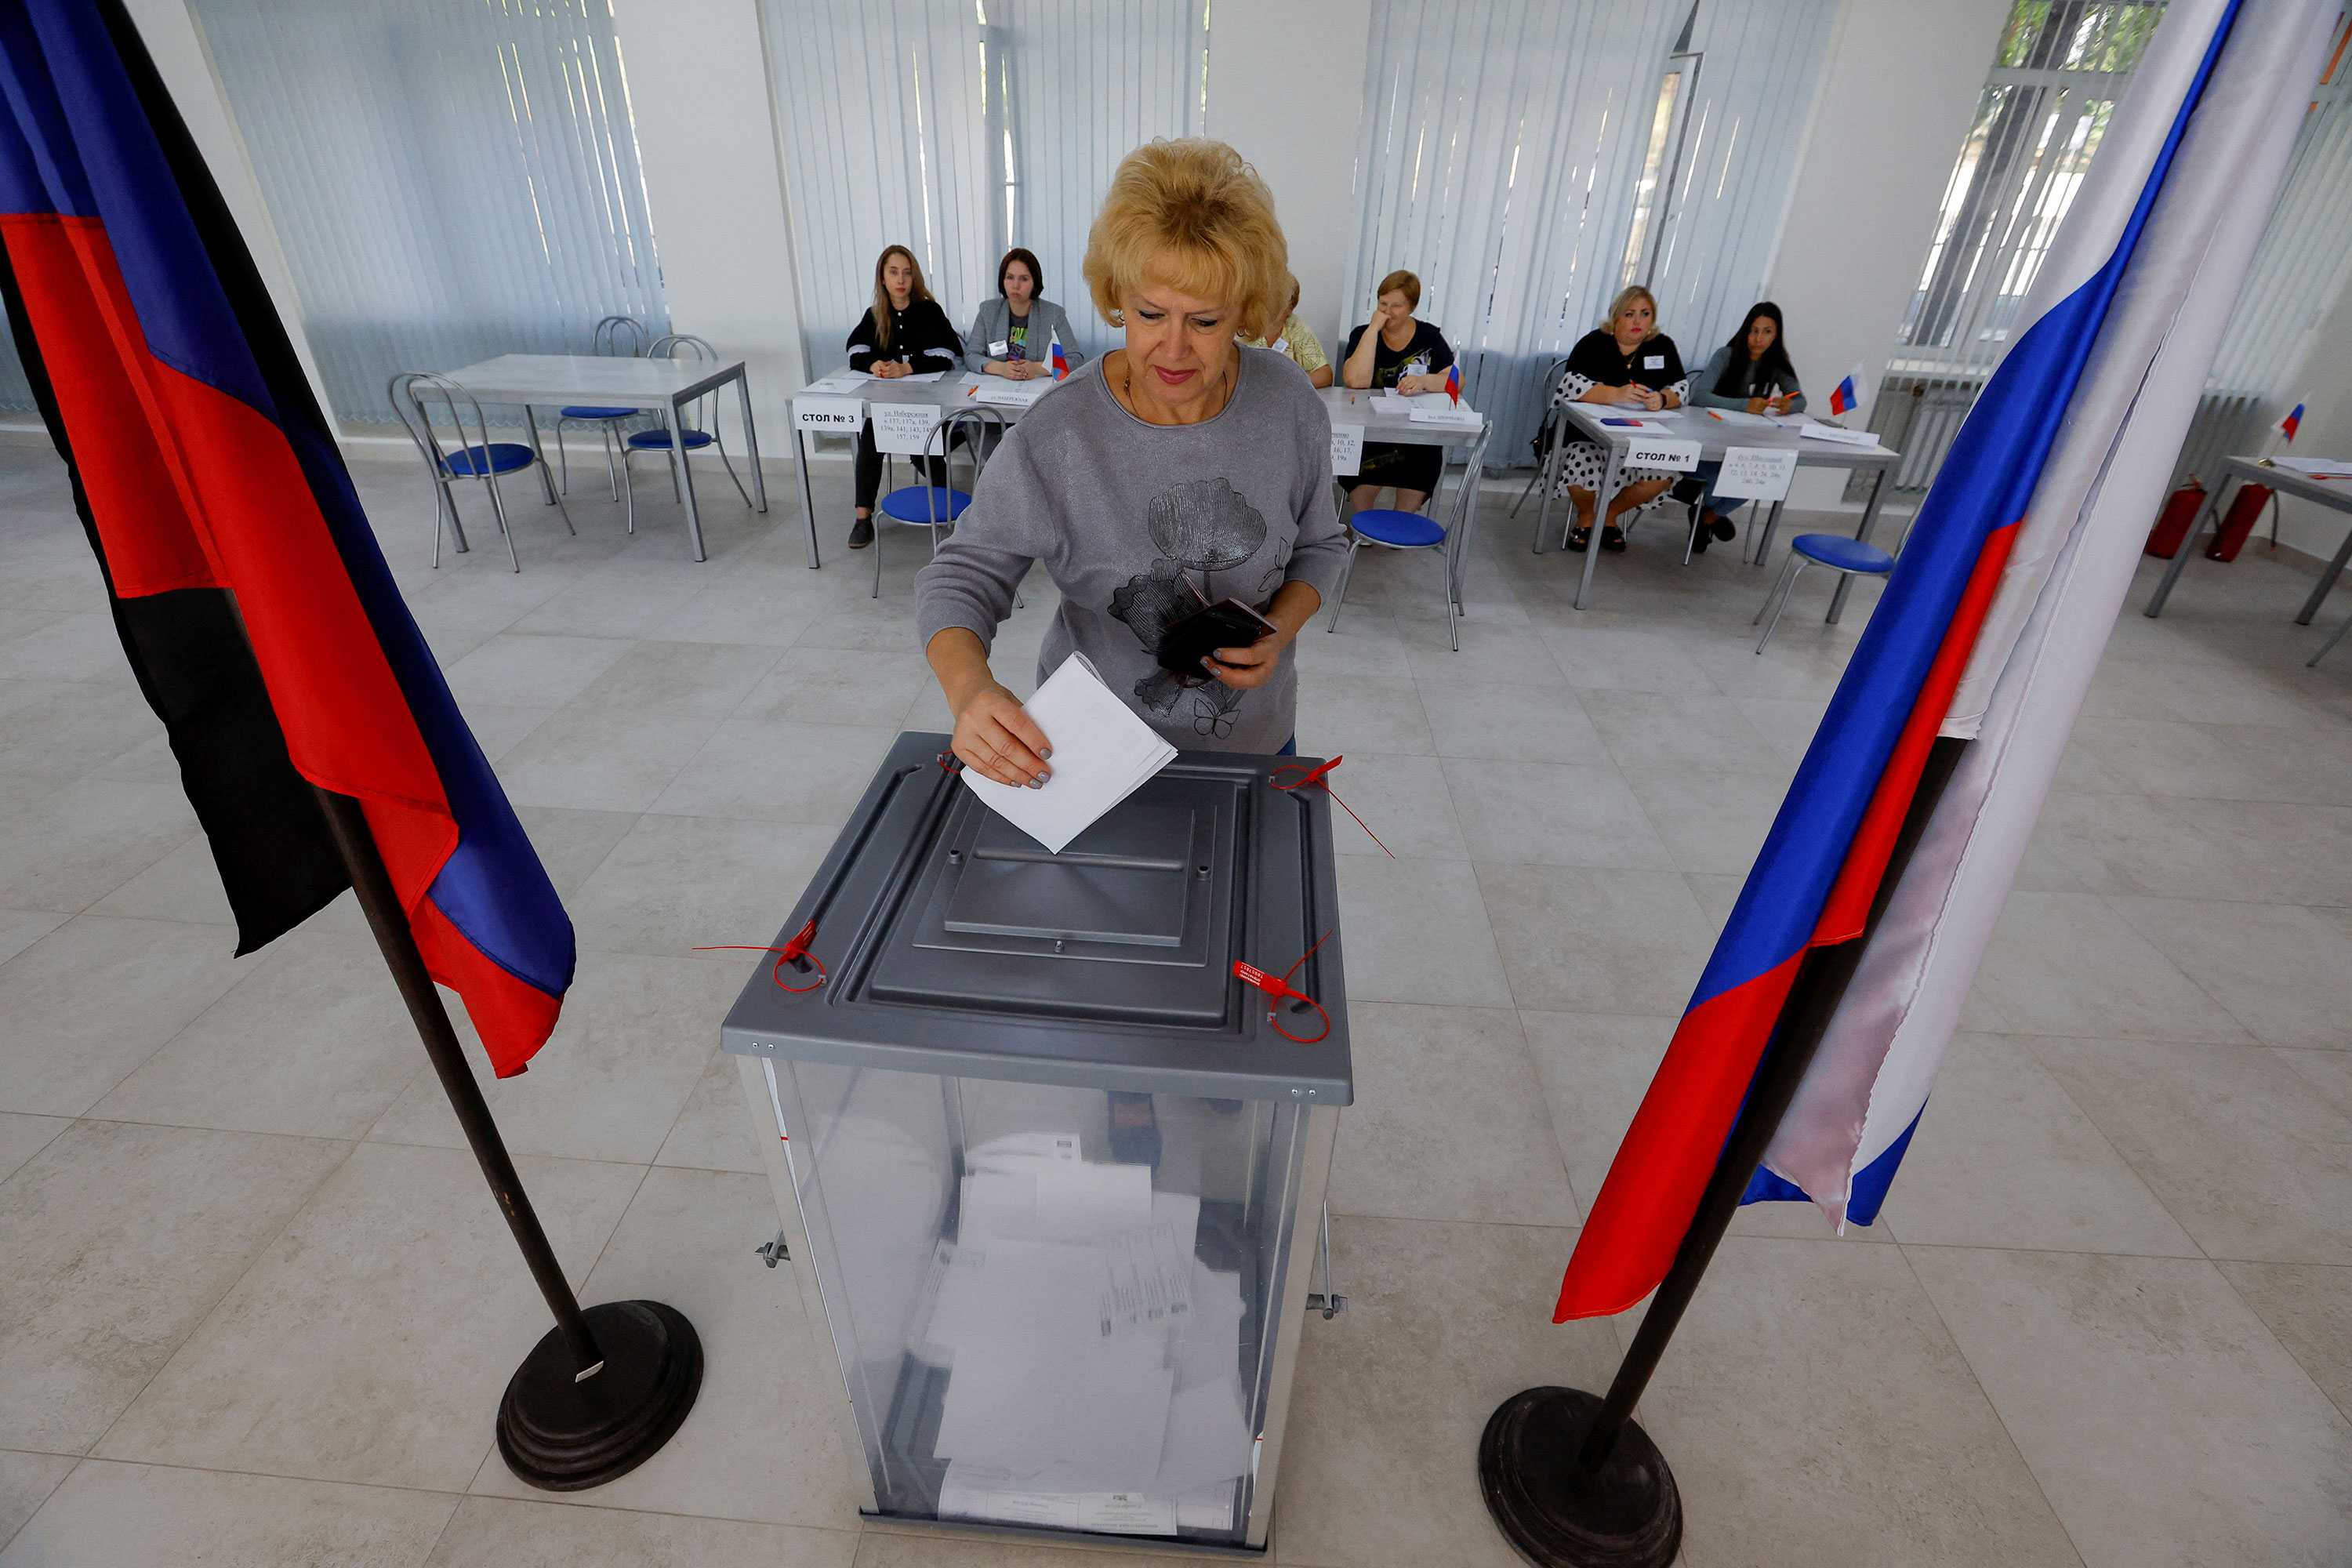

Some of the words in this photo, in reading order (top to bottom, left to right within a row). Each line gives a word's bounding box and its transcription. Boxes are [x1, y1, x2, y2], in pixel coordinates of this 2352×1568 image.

[802, 413, 830, 423] СТОЛ
[833, 414, 845, 423] №
[848, 415, 855, 423] 3
[1635, 452, 1666, 461] СТОЛ
